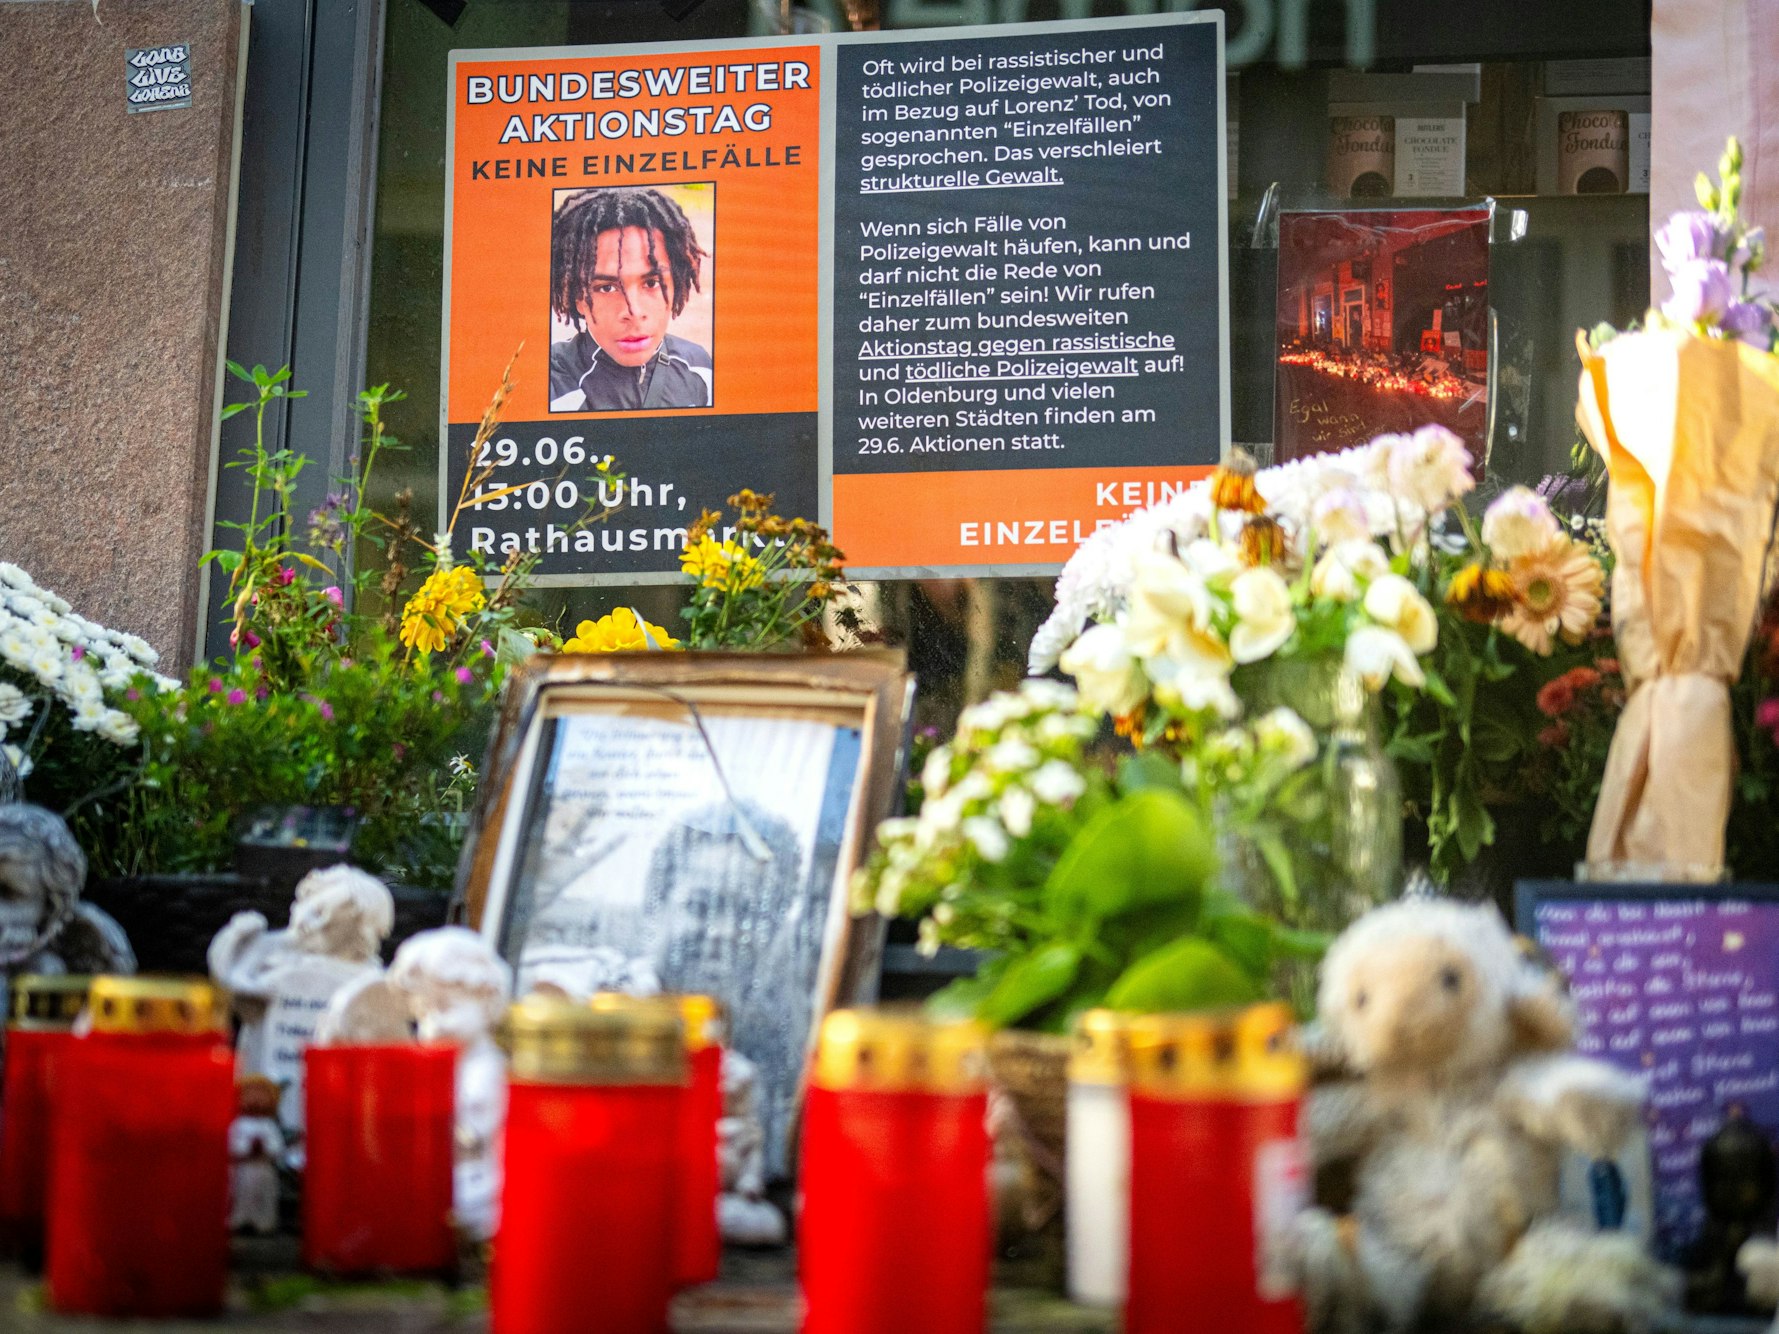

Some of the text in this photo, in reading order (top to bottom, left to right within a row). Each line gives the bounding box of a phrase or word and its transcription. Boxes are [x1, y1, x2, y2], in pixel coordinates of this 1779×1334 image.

[862, 42, 1164, 76] Oft wird bei rassistischer und
[467, 61, 811, 105] BUNDESWEITER
[861, 67, 1160, 99] tödlicher Polizeigewalt, auch
[862, 105, 888, 122] im
[894, 104, 959, 122] Bezug
[964, 98, 1000, 117] auf
[1083, 92, 1128, 111] Tod,
[1132, 94, 1171, 108] von
[499, 103, 772, 144] AKTIONSTAG
[860, 125, 998, 148] sogenannten
[472, 144, 802, 180] KEINE EINZELFÄLLE
[860, 138, 1162, 172] gesprochen. Das verschleiert
[860, 166, 1064, 193] strukturelle Gewalt.
[860, 214, 1066, 238] Wenn sich Fälle von
[860, 231, 1190, 263] Polizeigewalt häufen, kann und
[858, 261, 1102, 286] darf nicht die Rede von
[1000, 285, 1049, 304] sein!
[1054, 283, 1093, 302] Wir
[1098, 282, 1155, 301] rufen
[858, 307, 1129, 333] daher zum bundesweiten
[858, 332, 1176, 359] Aktionstag gegen rassistische
[859, 354, 1185, 382] und tödliche Polizeigewalt auf!
[859, 381, 1115, 406] In Oldenburg und vielen
[857, 406, 1156, 430] weiteren Städten finden am
[1289, 398, 1329, 423] Egal
[1316, 413, 1361, 426] wann
[858, 433, 1065, 455] 29.6. Aktionen statt.
[1311, 430, 1332, 443] wir
[470, 477, 687, 511] 13:00 Uhr,
